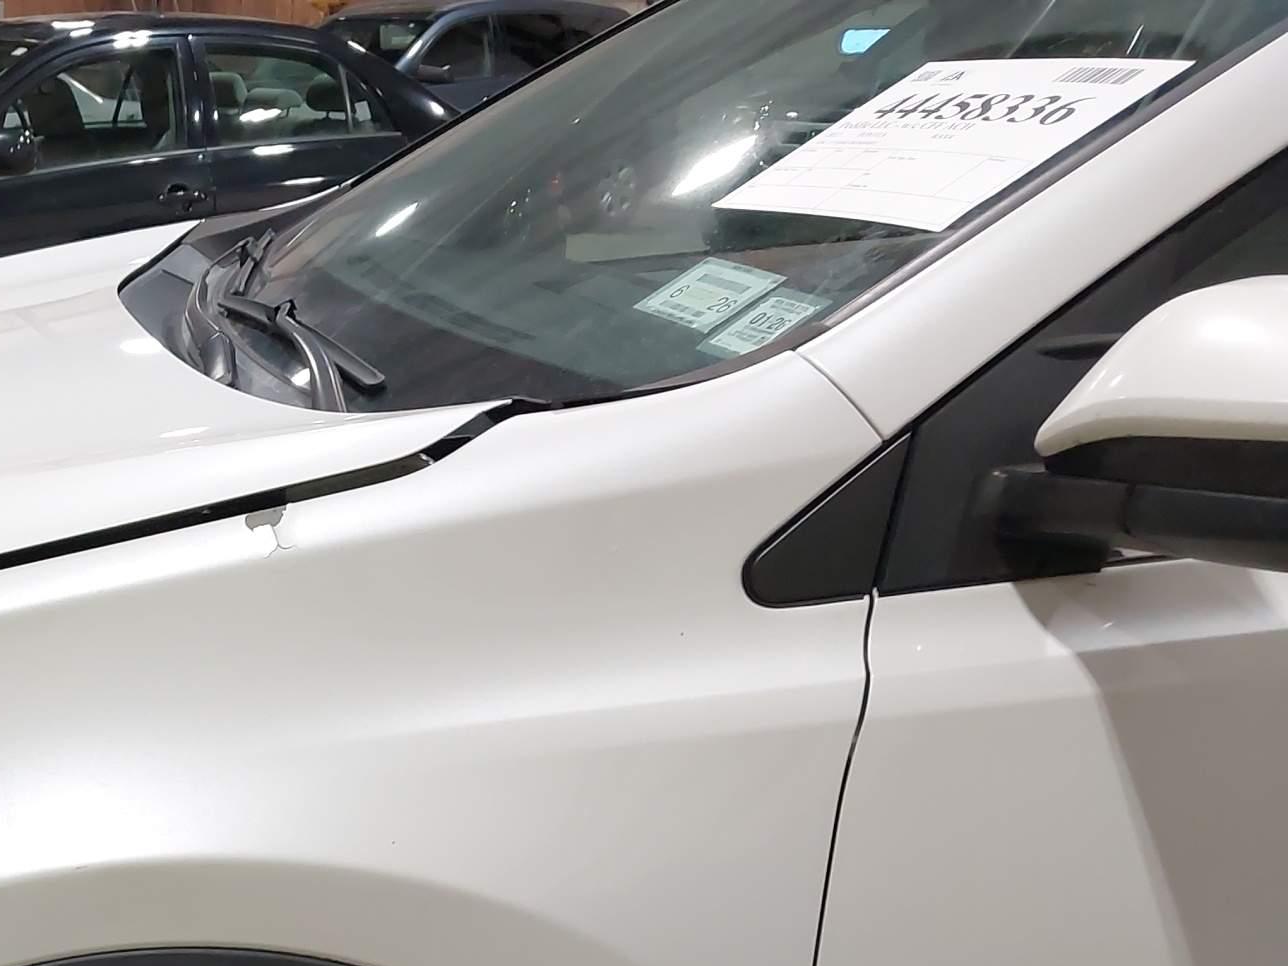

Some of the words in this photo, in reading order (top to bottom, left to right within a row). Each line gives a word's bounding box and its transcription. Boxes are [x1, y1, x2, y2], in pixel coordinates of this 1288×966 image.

[874, 93, 1096, 125] 44458336
[670, 284, 691, 298] 6
[707, 296, 738, 313] 26
